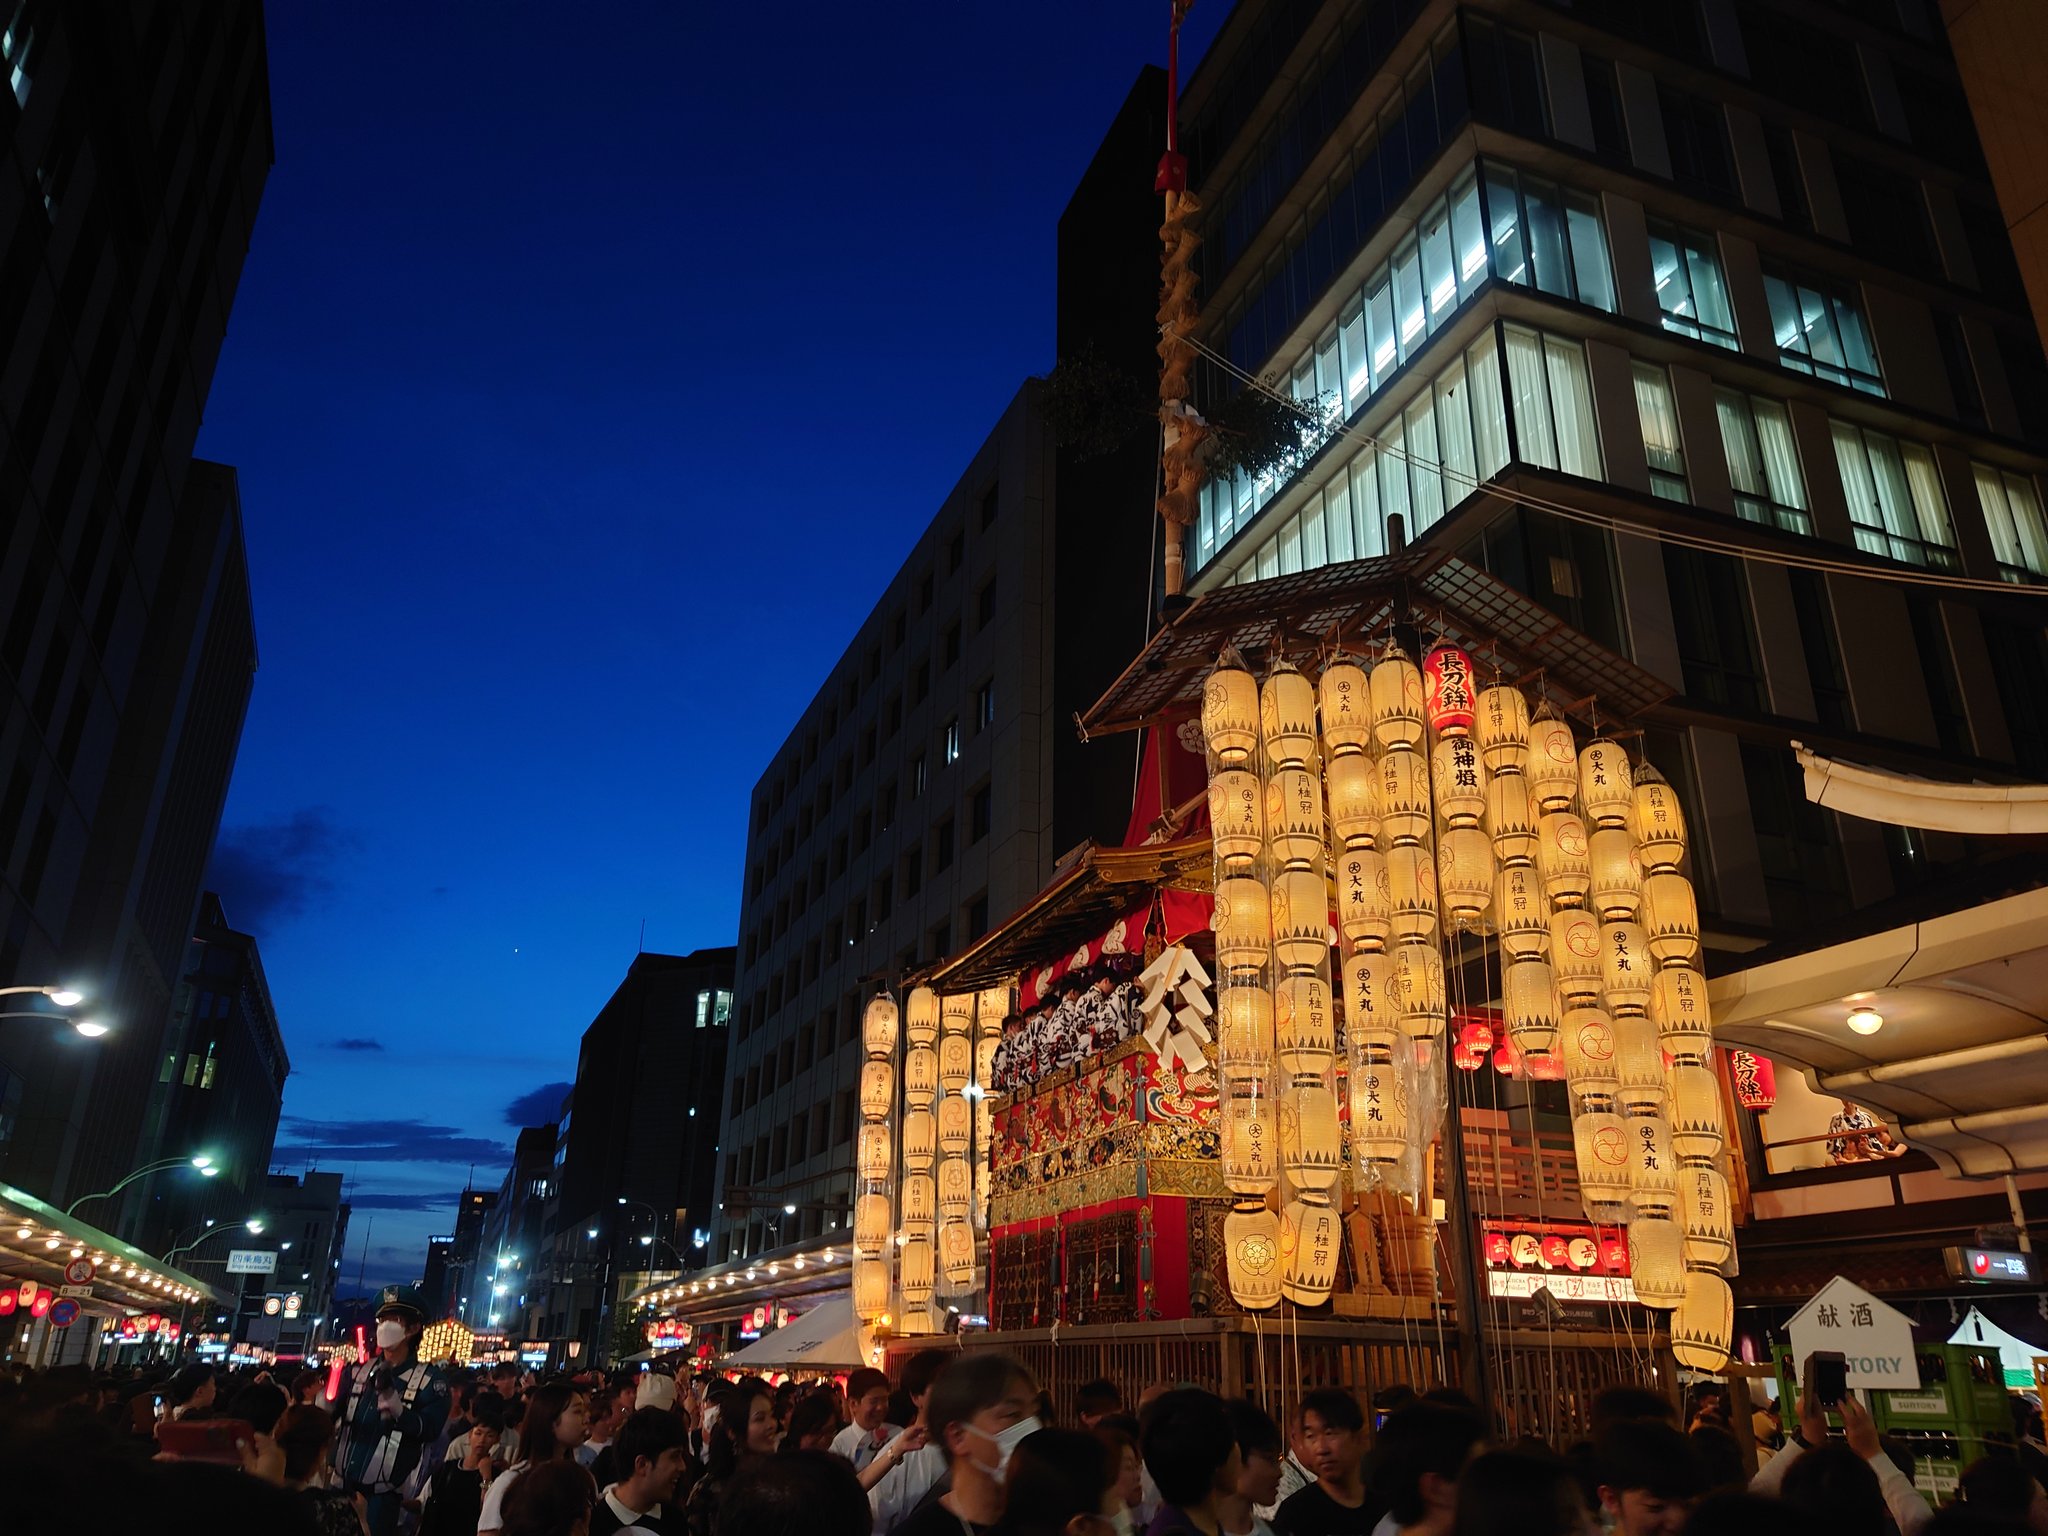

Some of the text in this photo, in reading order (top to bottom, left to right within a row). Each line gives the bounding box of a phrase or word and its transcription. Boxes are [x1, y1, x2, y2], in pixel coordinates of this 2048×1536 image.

[1437, 651, 1469, 711] 長刀鉾
[1340, 694, 1351, 713] 大丸
[1488, 690, 1504, 727] 月桂冠
[1384, 757, 1399, 796] 月桂冠
[1591, 761, 1607, 787] 大丸
[1297, 774, 1314, 815] 月桂冠
[1649, 786, 1668, 823] 月桂冠
[1243, 803, 1254, 823] 大丸
[1349, 874, 1365, 904] 大丸
[1511, 871, 1528, 911] 月桂冠
[1614, 944, 1632, 972] 大丸
[1308, 982, 1324, 1028] 月桂冠
[1357, 982, 1374, 1013] 大丸
[1677, 972, 1695, 1013] 月桂冠
[1733, 1052, 1761, 1099] 長刀鉾
[1367, 1090, 1383, 1122] 大丸
[1250, 1140, 1262, 1163] 大丸
[1641, 1139, 1659, 1171] 大丸
[1697, 1172, 1715, 1217] 月桂冠
[1312, 1216, 1331, 1266] 月桂冠
[1817, 1301, 1874, 1329] 献酒
[1847, 1356, 1902, 1375] TORY
